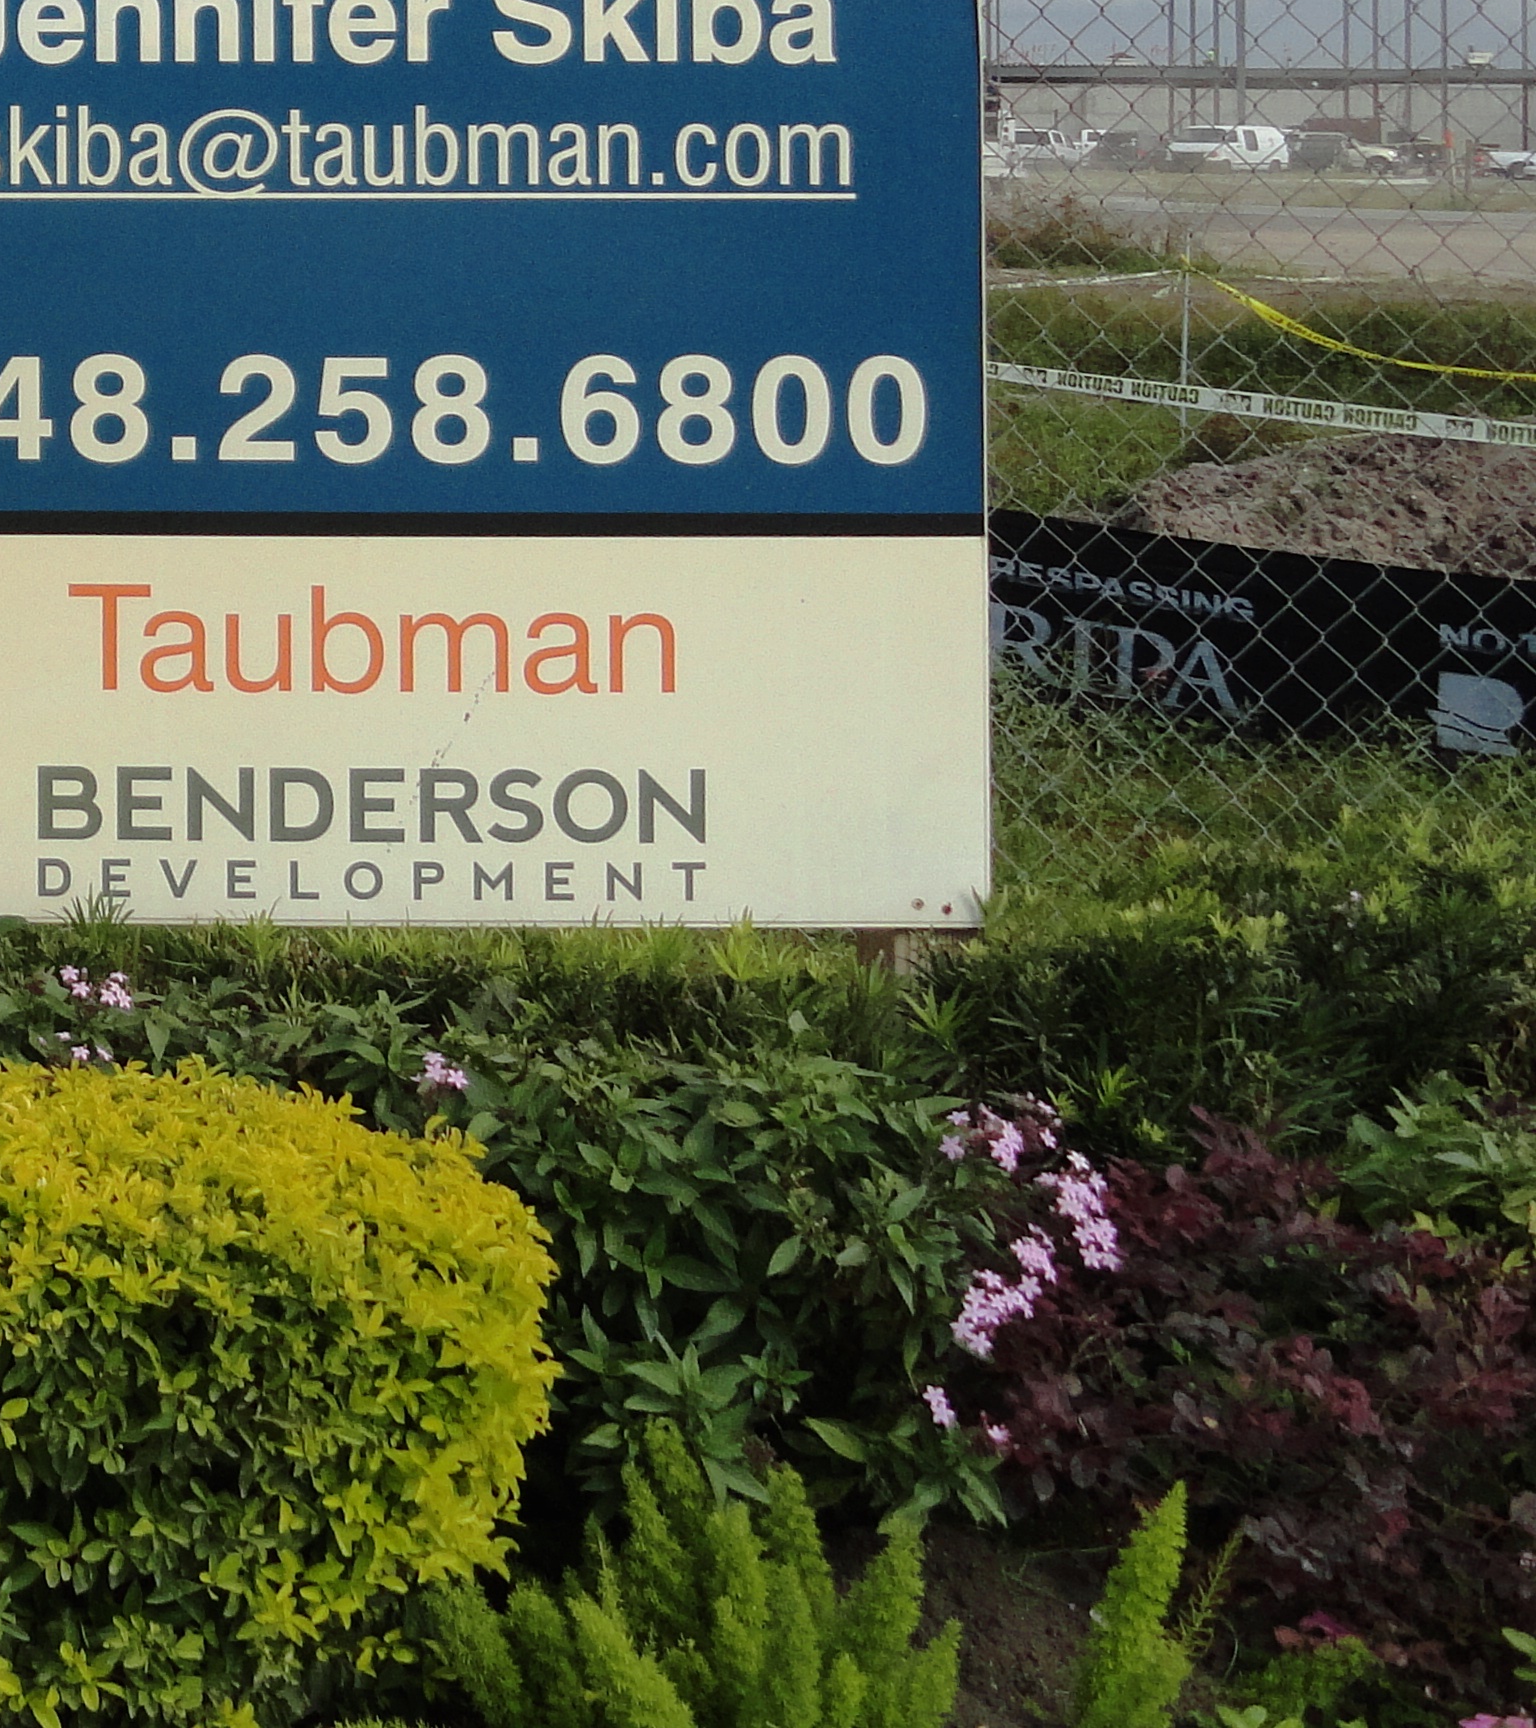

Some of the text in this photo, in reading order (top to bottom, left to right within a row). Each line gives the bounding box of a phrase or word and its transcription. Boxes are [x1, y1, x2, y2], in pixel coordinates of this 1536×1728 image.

[989, 555, 1255, 620] RESPASSING
[68, 583, 676, 696] Taubman
[1439, 623, 1507, 652] NO
[37, 765, 707, 844] BENDERSON
[37, 857, 707, 901] DEVELOPMENT
